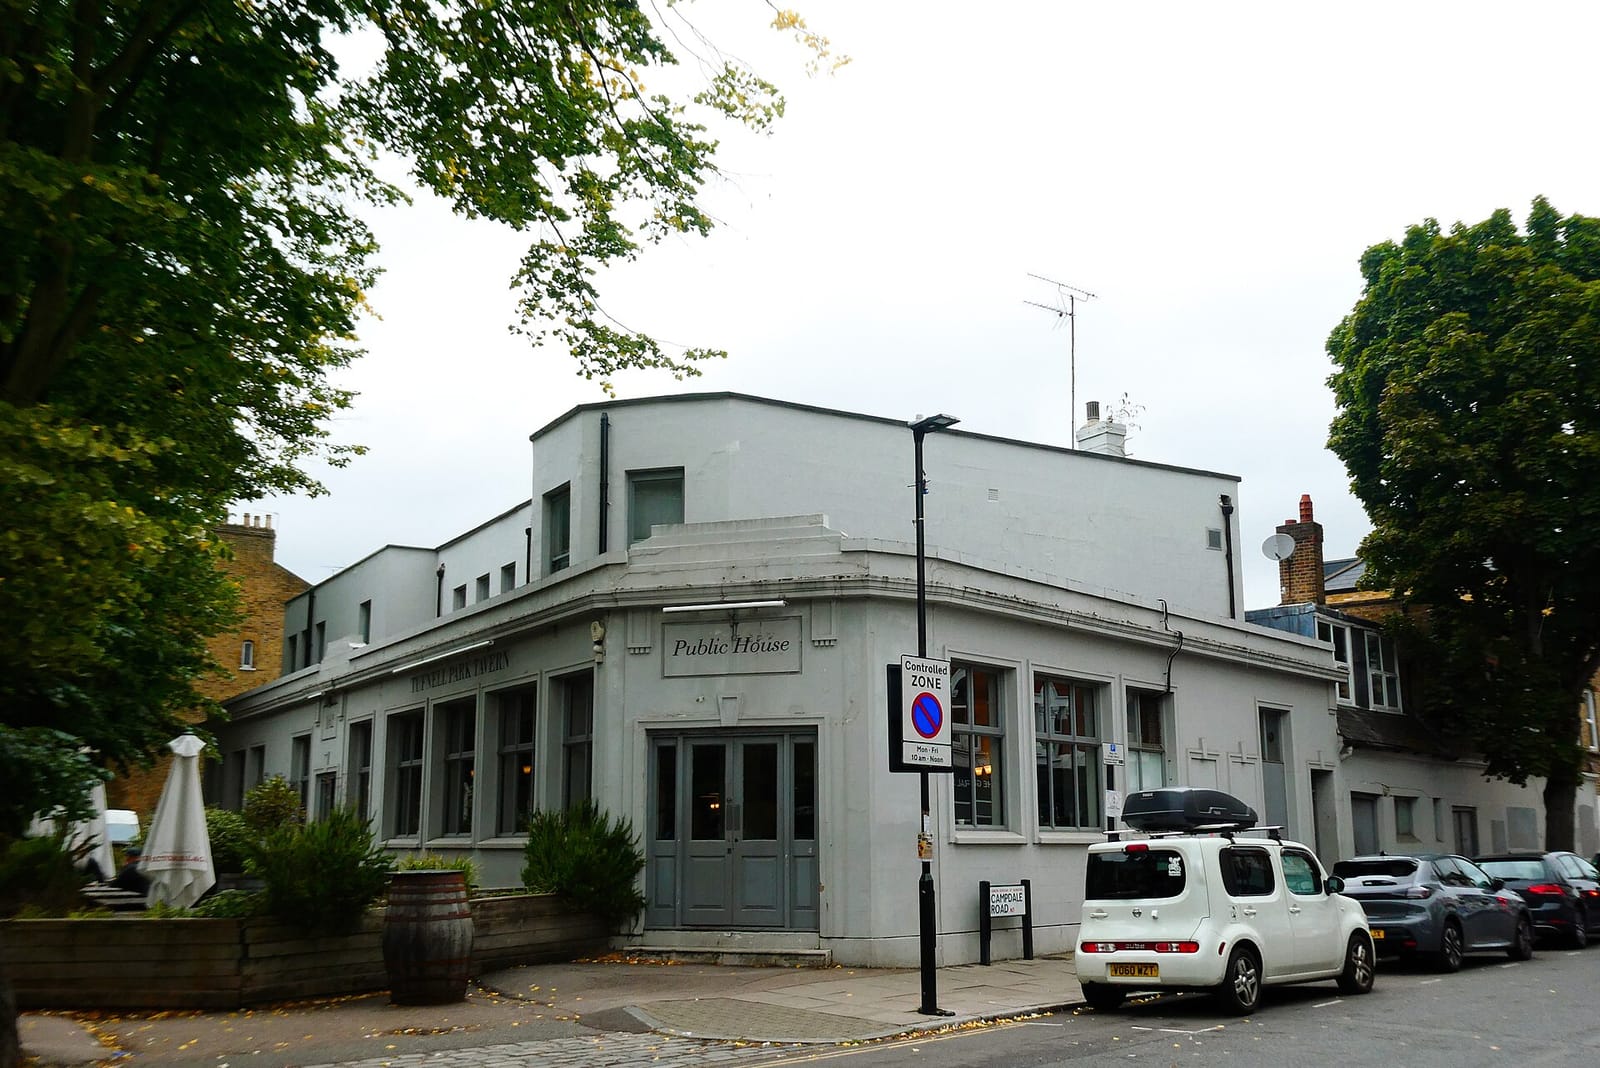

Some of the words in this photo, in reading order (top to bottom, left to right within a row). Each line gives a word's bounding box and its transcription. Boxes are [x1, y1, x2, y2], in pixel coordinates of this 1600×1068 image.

[673, 638, 728, 656] Public
[733, 637, 790, 654] House
[448, 662, 471, 685] PARK
[473, 650, 510, 677] TAVERN
[905, 660, 948, 676] Controlled
[911, 675, 942, 689] ZONE
[916, 745, 928, 753] Mon
[931, 746, 939, 754] Fri
[991, 892, 1023, 904] CAMPDALE
[991, 904, 1009, 914] ROAD
[1137, 964, 1155, 976] WZT
